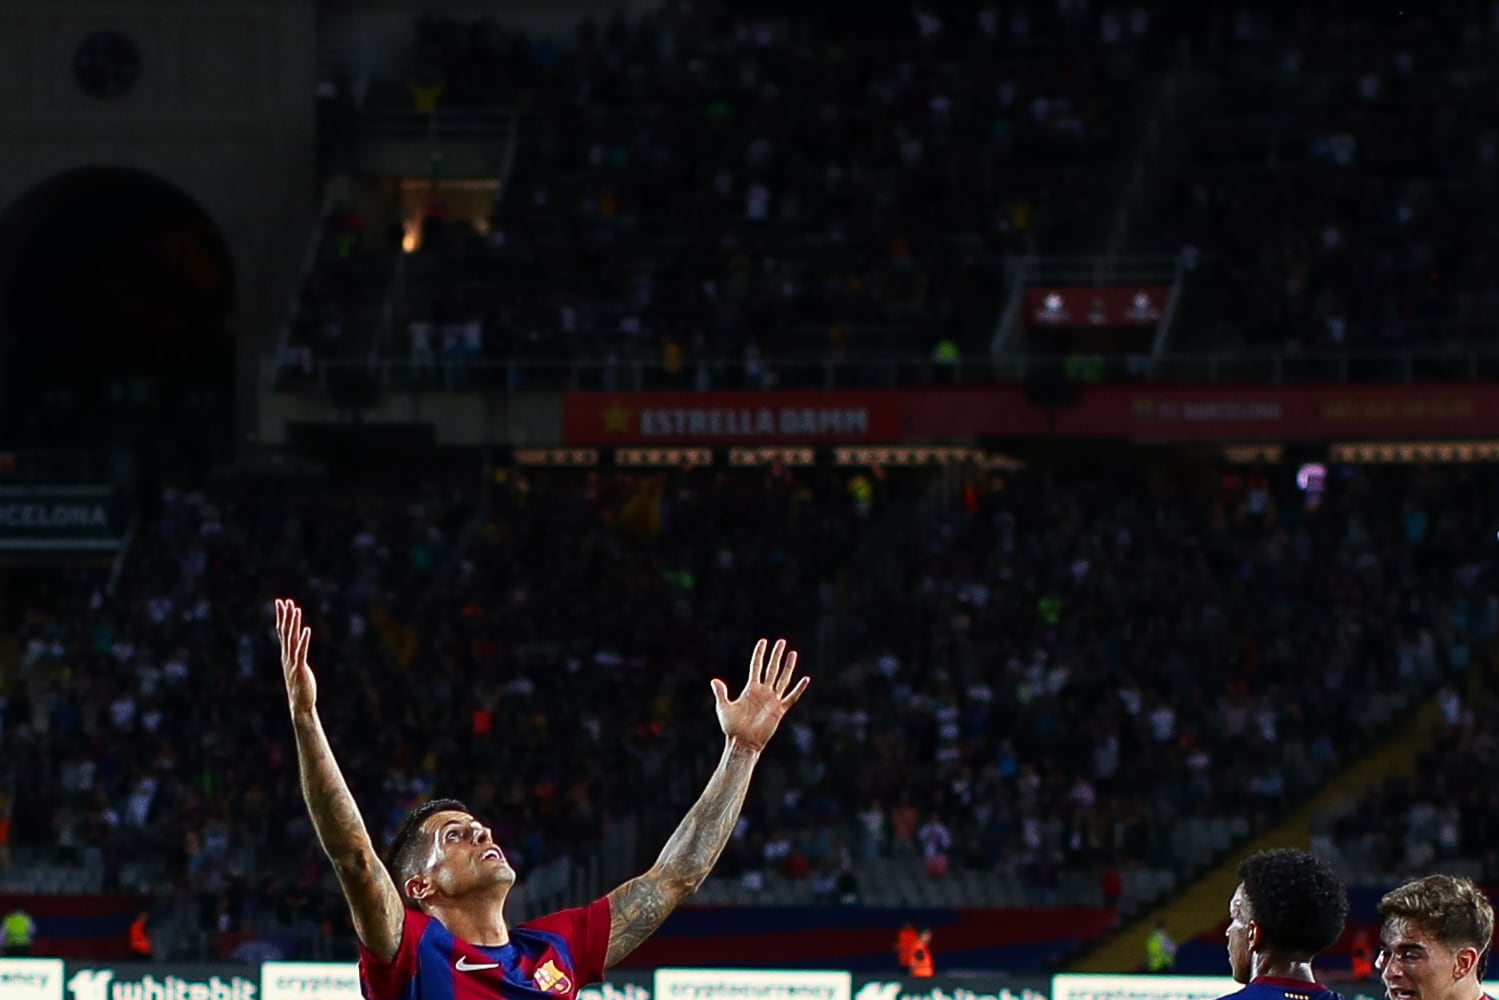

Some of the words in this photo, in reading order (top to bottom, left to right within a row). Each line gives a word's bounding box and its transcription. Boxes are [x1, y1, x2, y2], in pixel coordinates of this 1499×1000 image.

[639, 407, 775, 436] ESTRELLA
[779, 407, 870, 435] DAMM
[671, 984, 836, 1000] cryptocurrency
